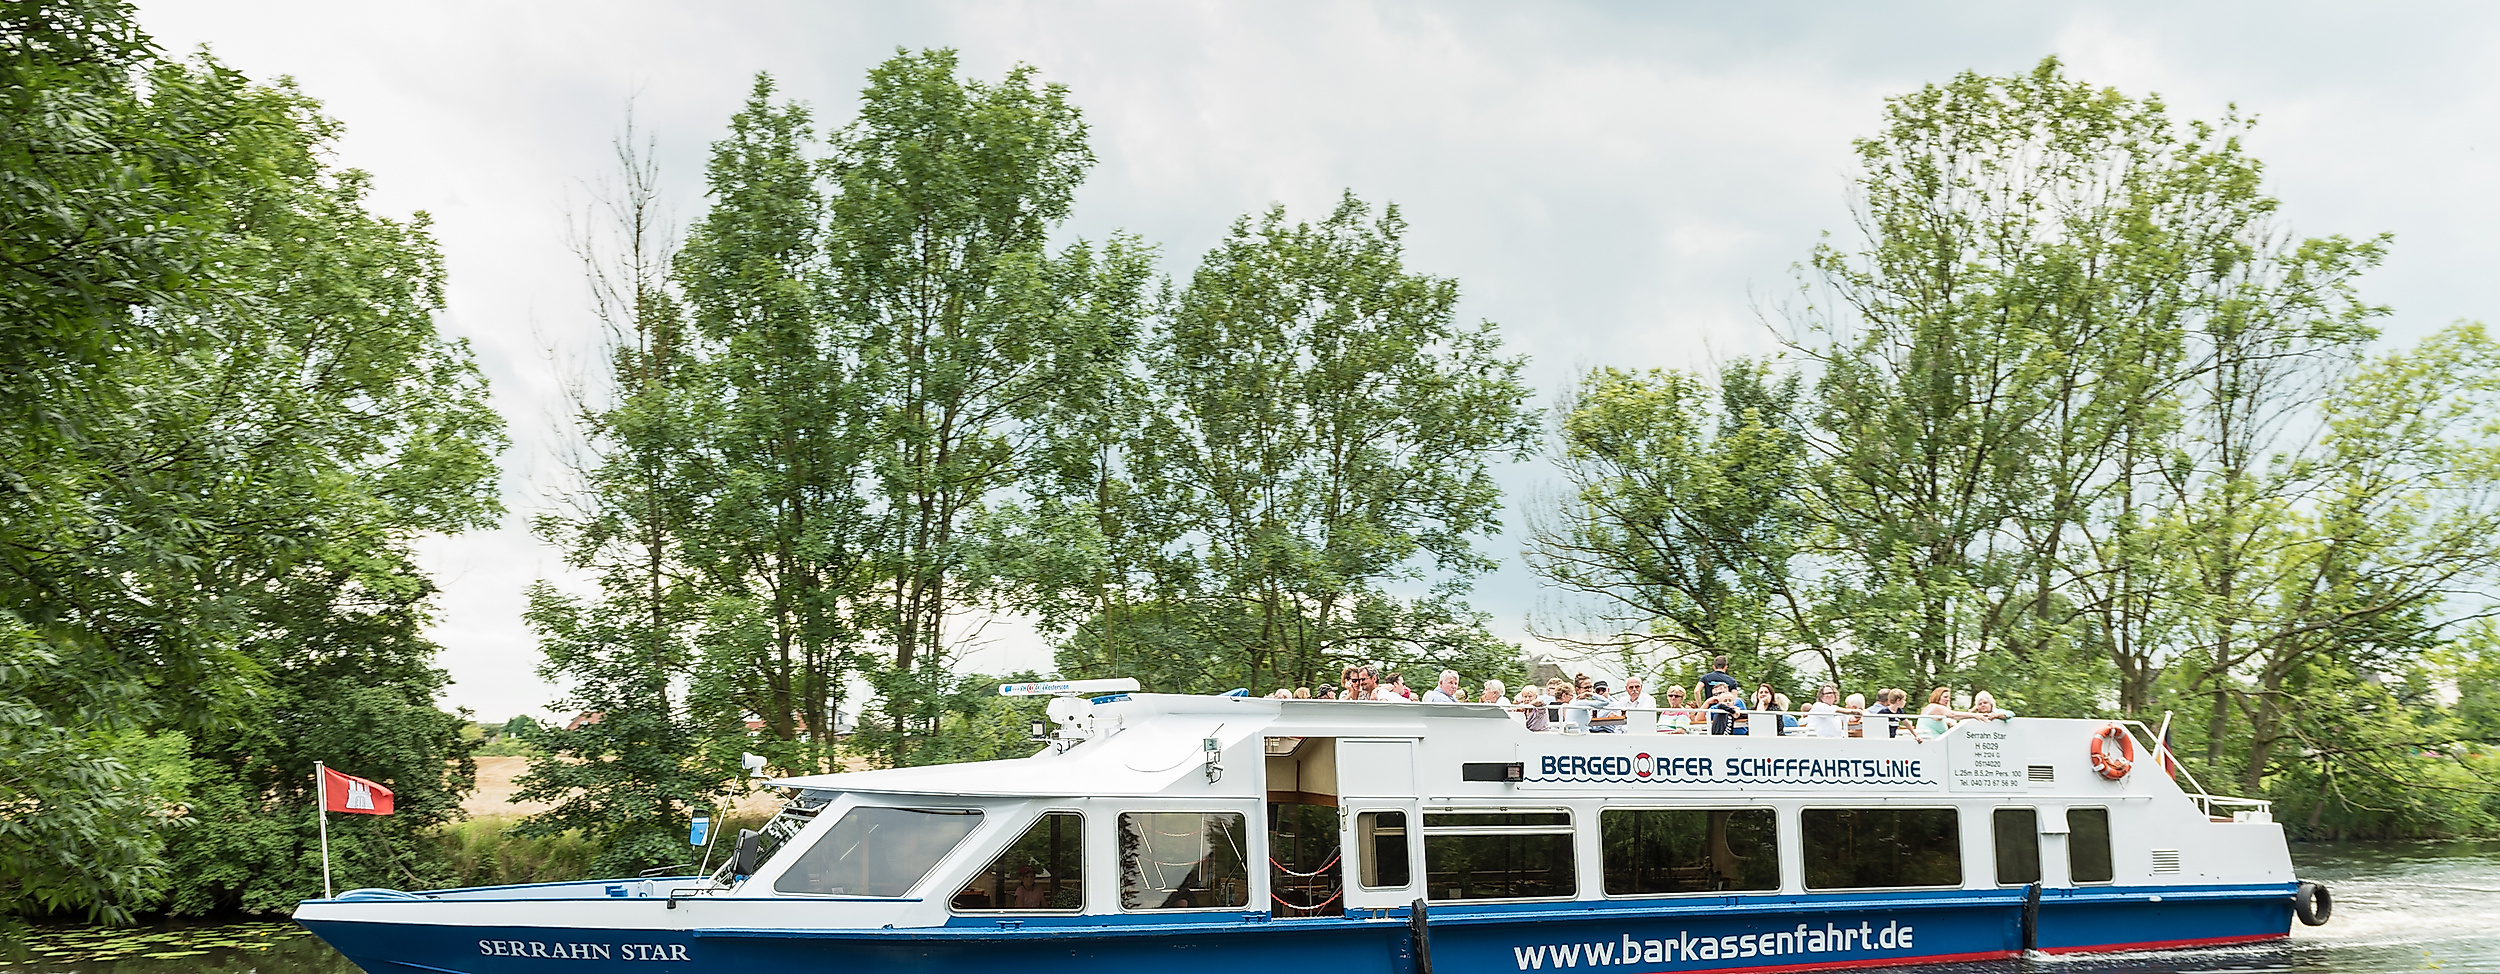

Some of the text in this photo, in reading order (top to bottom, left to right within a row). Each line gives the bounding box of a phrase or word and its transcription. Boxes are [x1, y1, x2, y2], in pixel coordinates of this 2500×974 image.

[1965, 731, 2007, 740] Serrahn Star
[1974, 742, 1999, 751] H 6029
[1541, 754, 1713, 777] BERGEDORFER
[2011, 770, 2022, 778] 100
[1970, 779, 1983, 787] 040
[1513, 920, 1914, 971] www.barkassenfahrt.de
[478, 939, 691, 962] SERRAHN STAR
